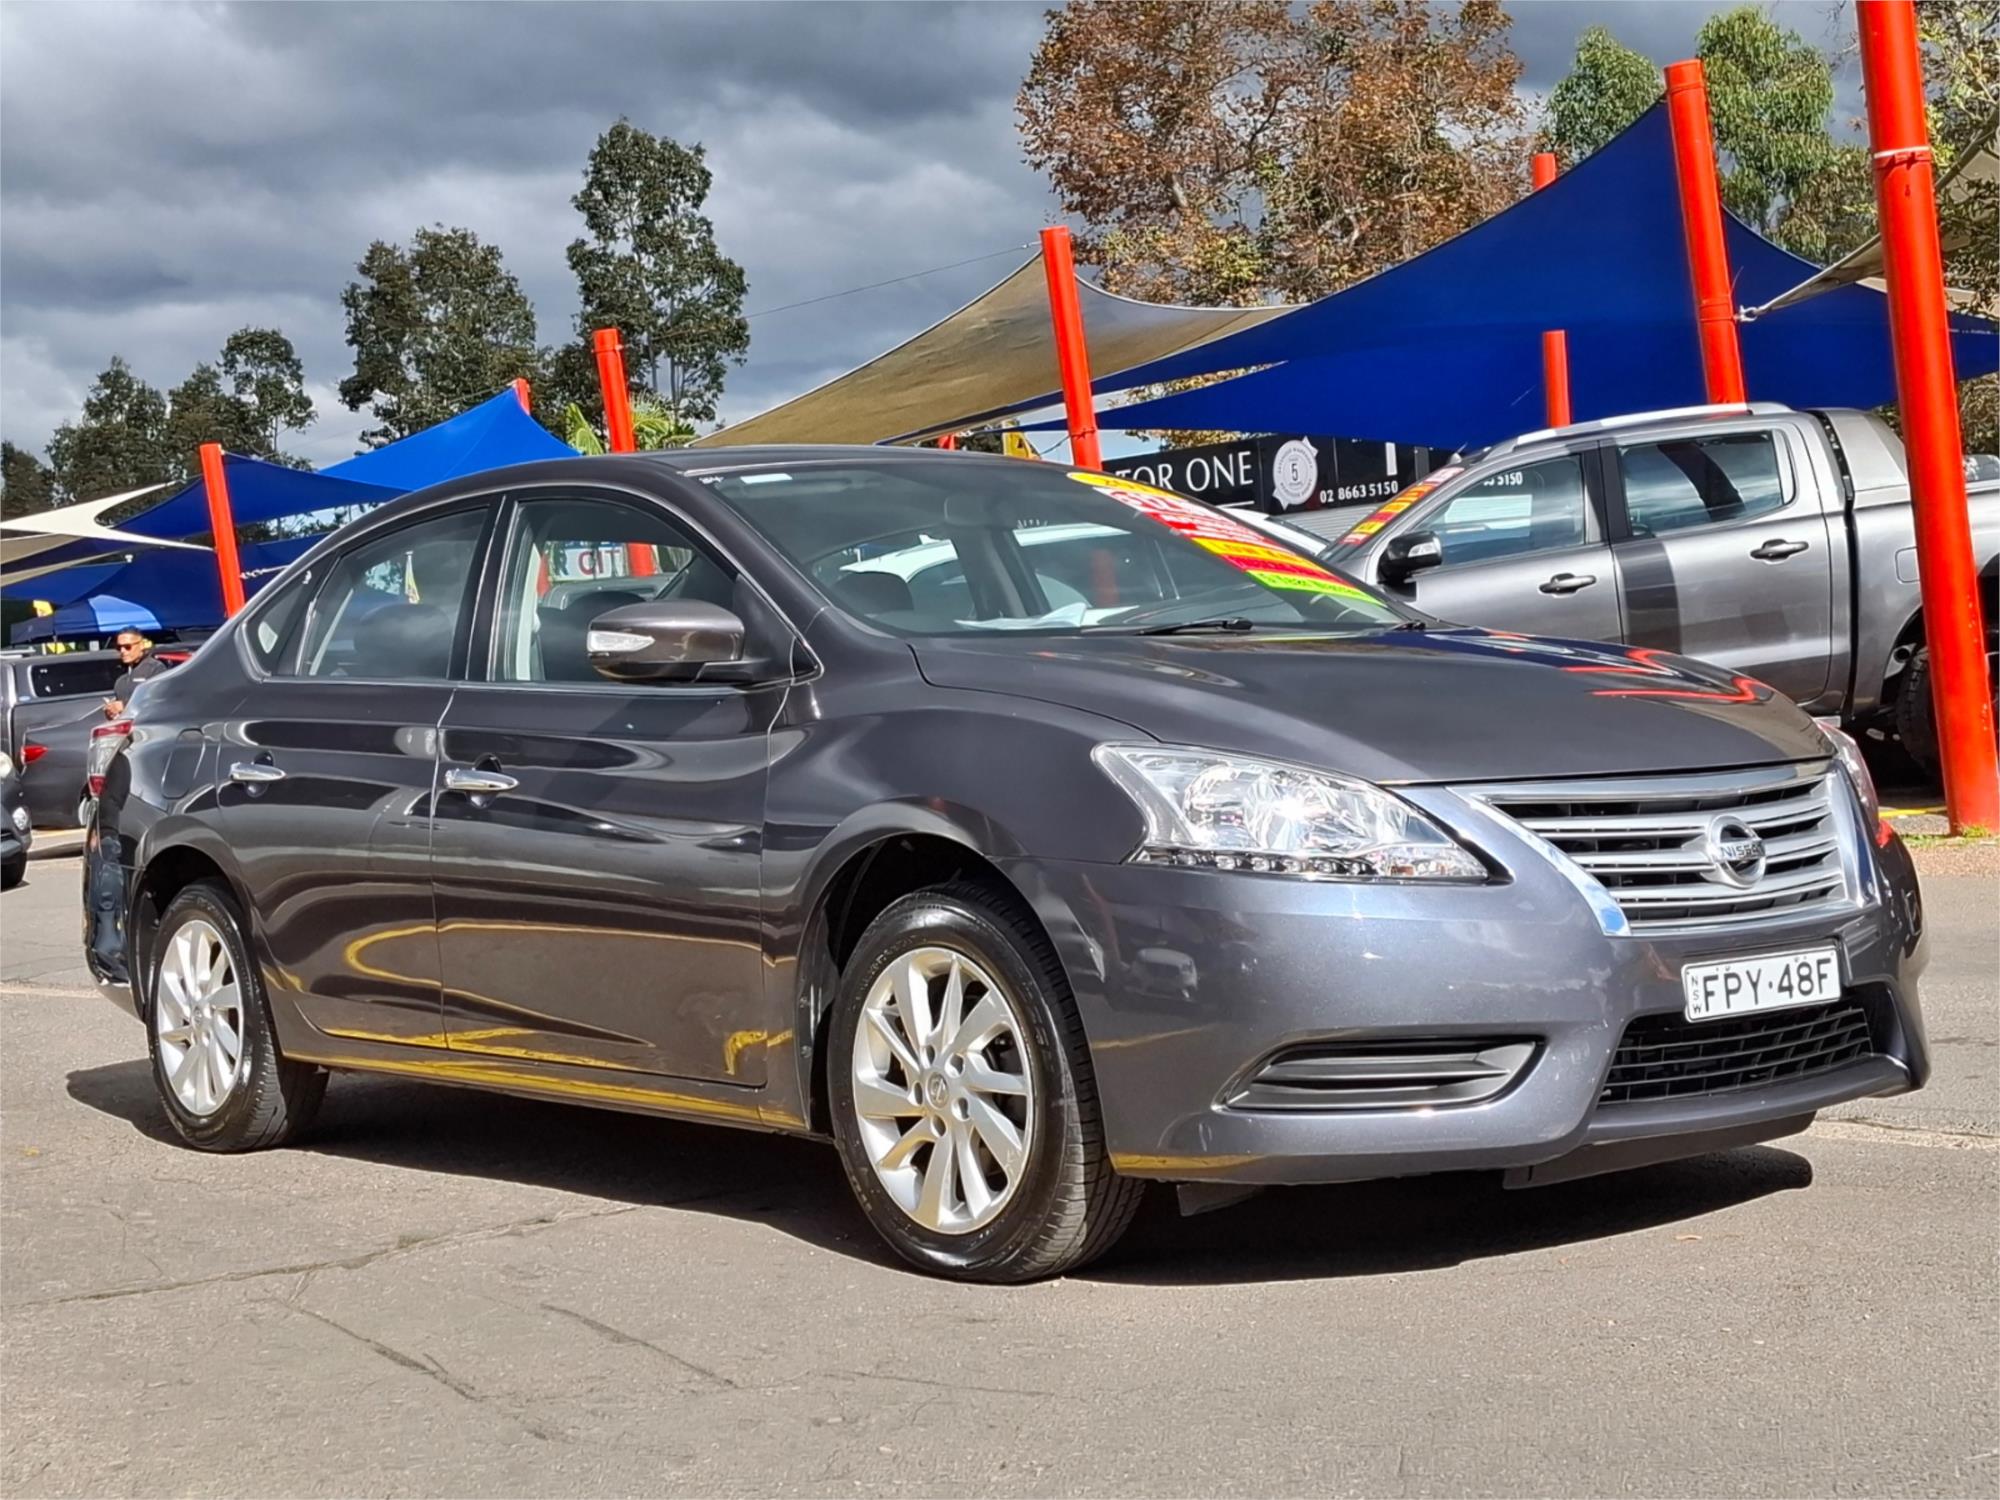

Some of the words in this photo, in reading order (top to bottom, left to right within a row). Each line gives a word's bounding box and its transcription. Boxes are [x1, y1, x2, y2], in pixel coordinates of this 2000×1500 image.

[1186, 451, 1253, 492] ONE
[1319, 489, 1334, 503] 02
[1338, 483, 1367, 501] 8663
[1368, 480, 1399, 497] 5150
